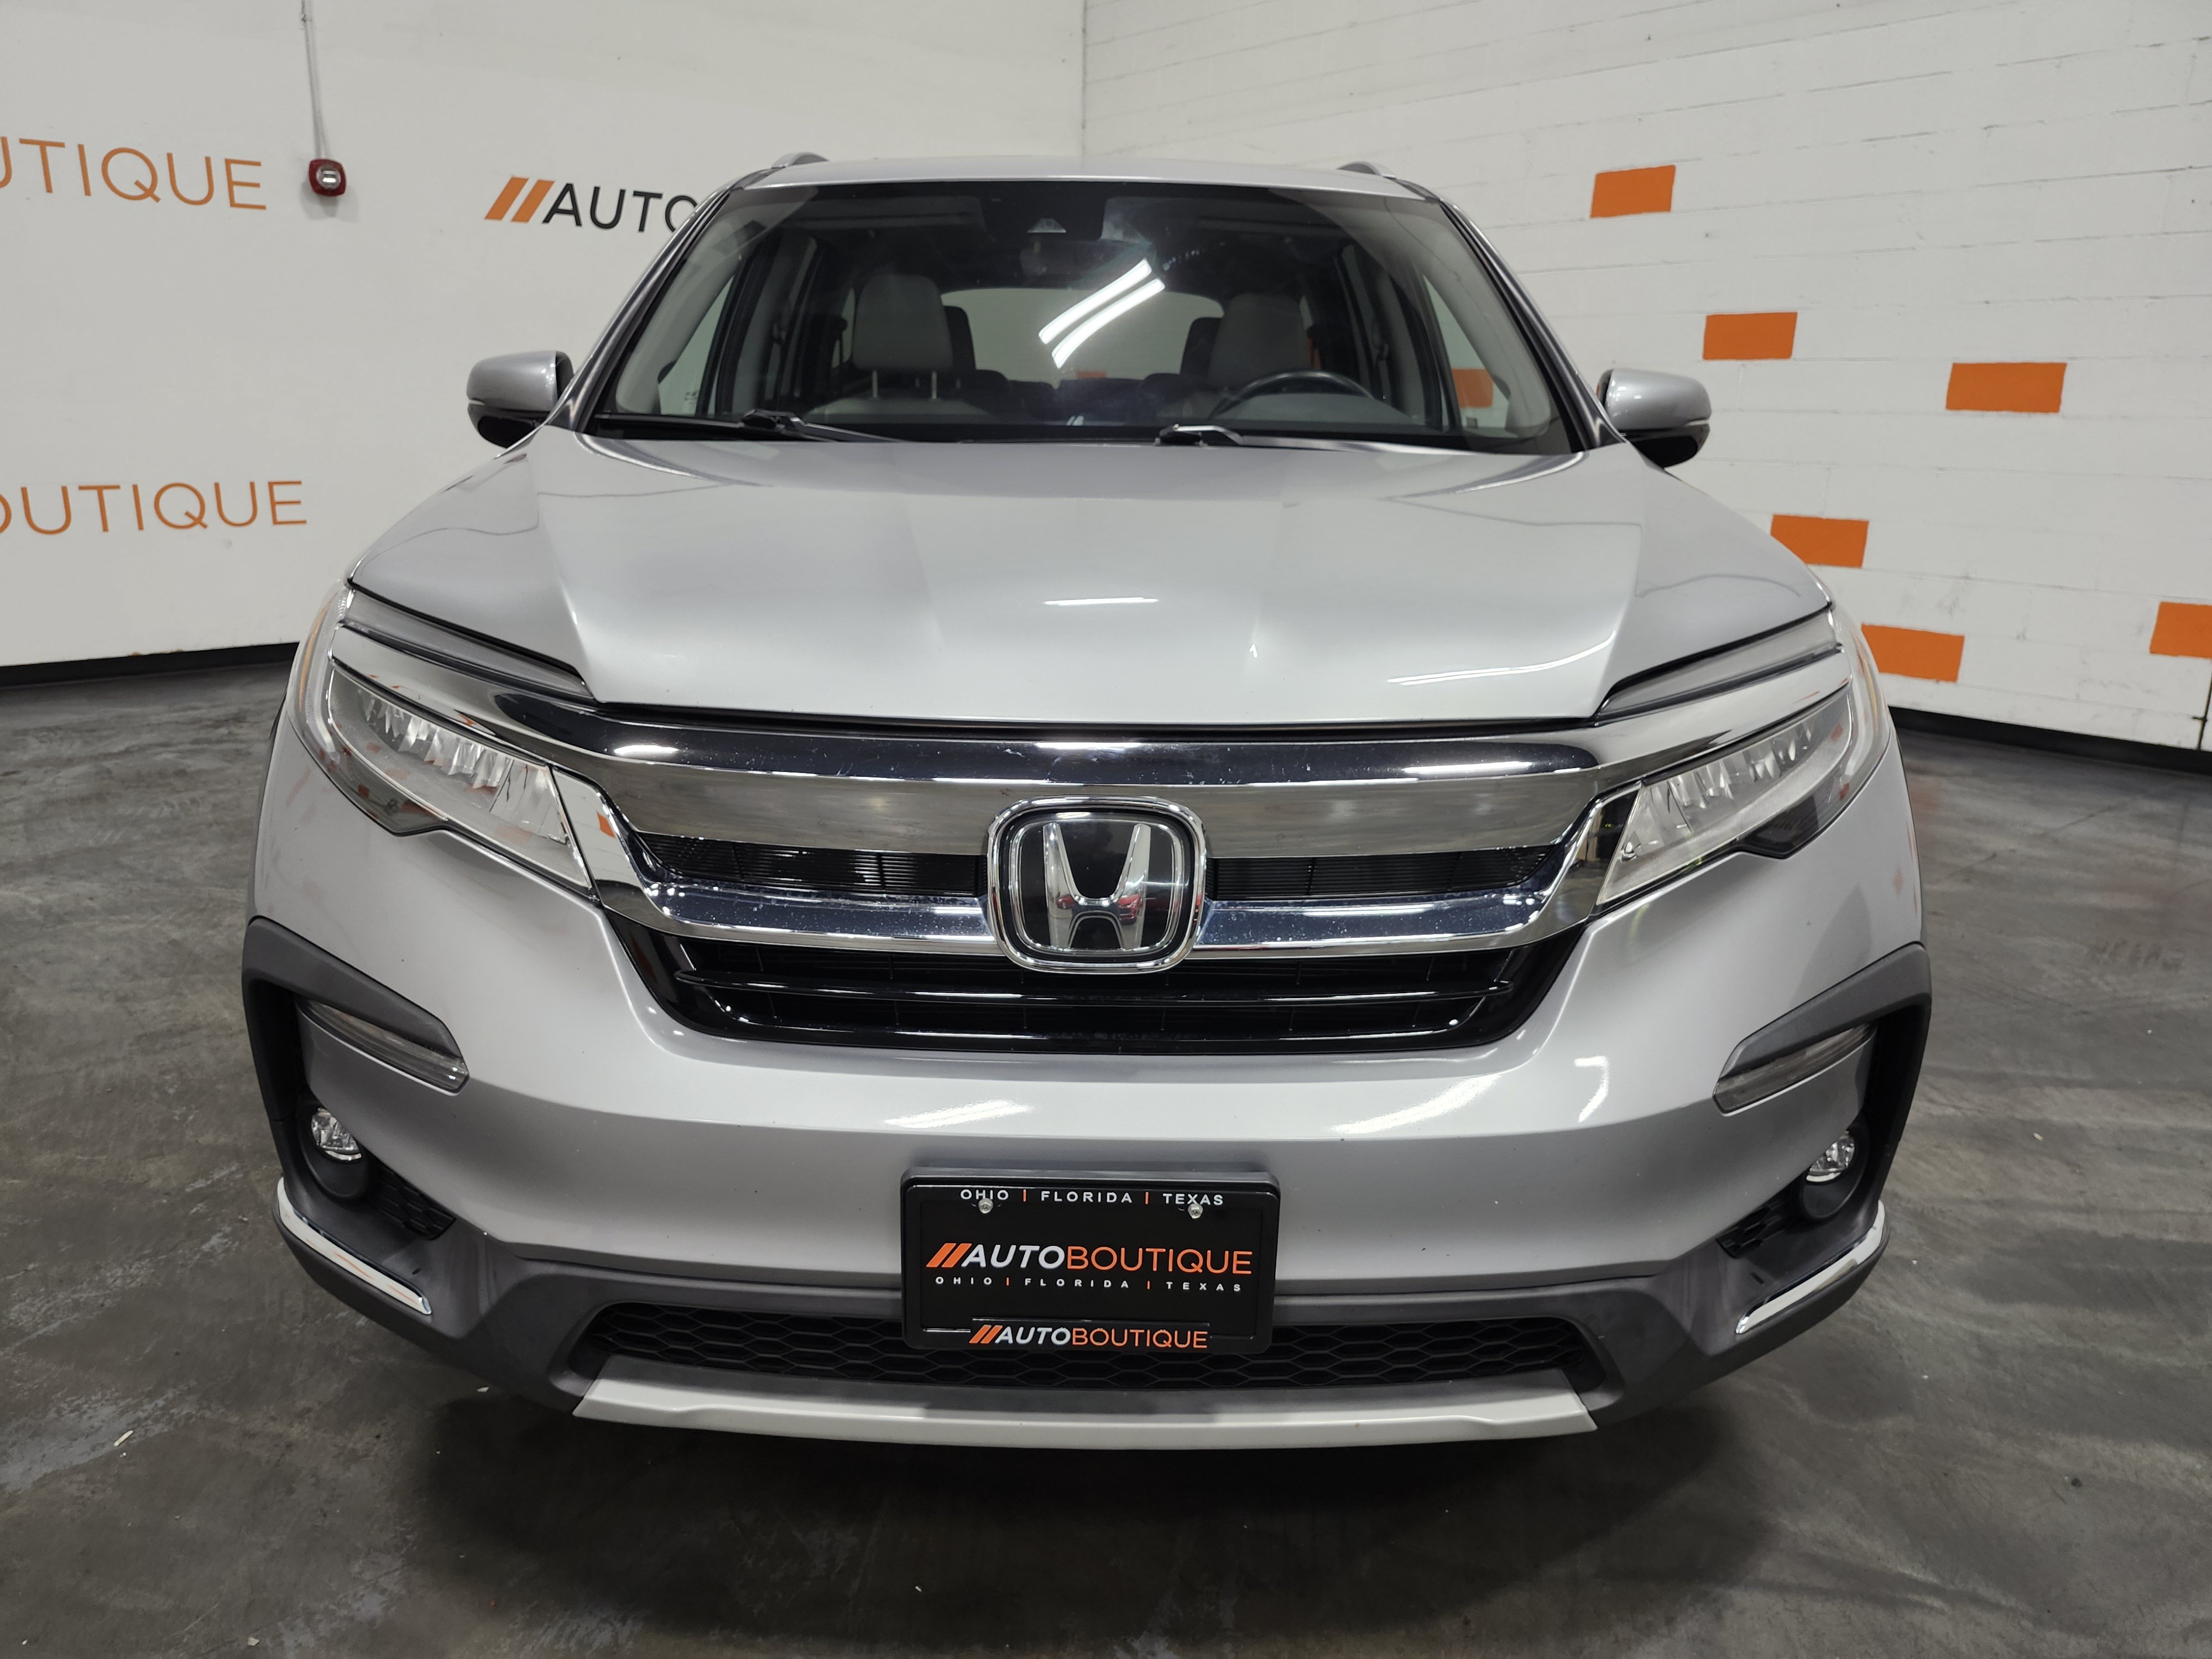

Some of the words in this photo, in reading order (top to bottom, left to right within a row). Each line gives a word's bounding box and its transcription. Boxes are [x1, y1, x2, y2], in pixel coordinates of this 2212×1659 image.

[0, 136, 267, 211] TIQUE
[0, 481, 307, 535] UTIQUE
[960, 1189, 1009, 1201] OHIO
[1040, 1191, 1133, 1203] FLORIDA
[1162, 1193, 1224, 1206] TEXAS
[935, 1276, 992, 1285] OHIO
[1025, 1278, 1129, 1288] FLORIDA
[1166, 1281, 1241, 1292] TEXAS
